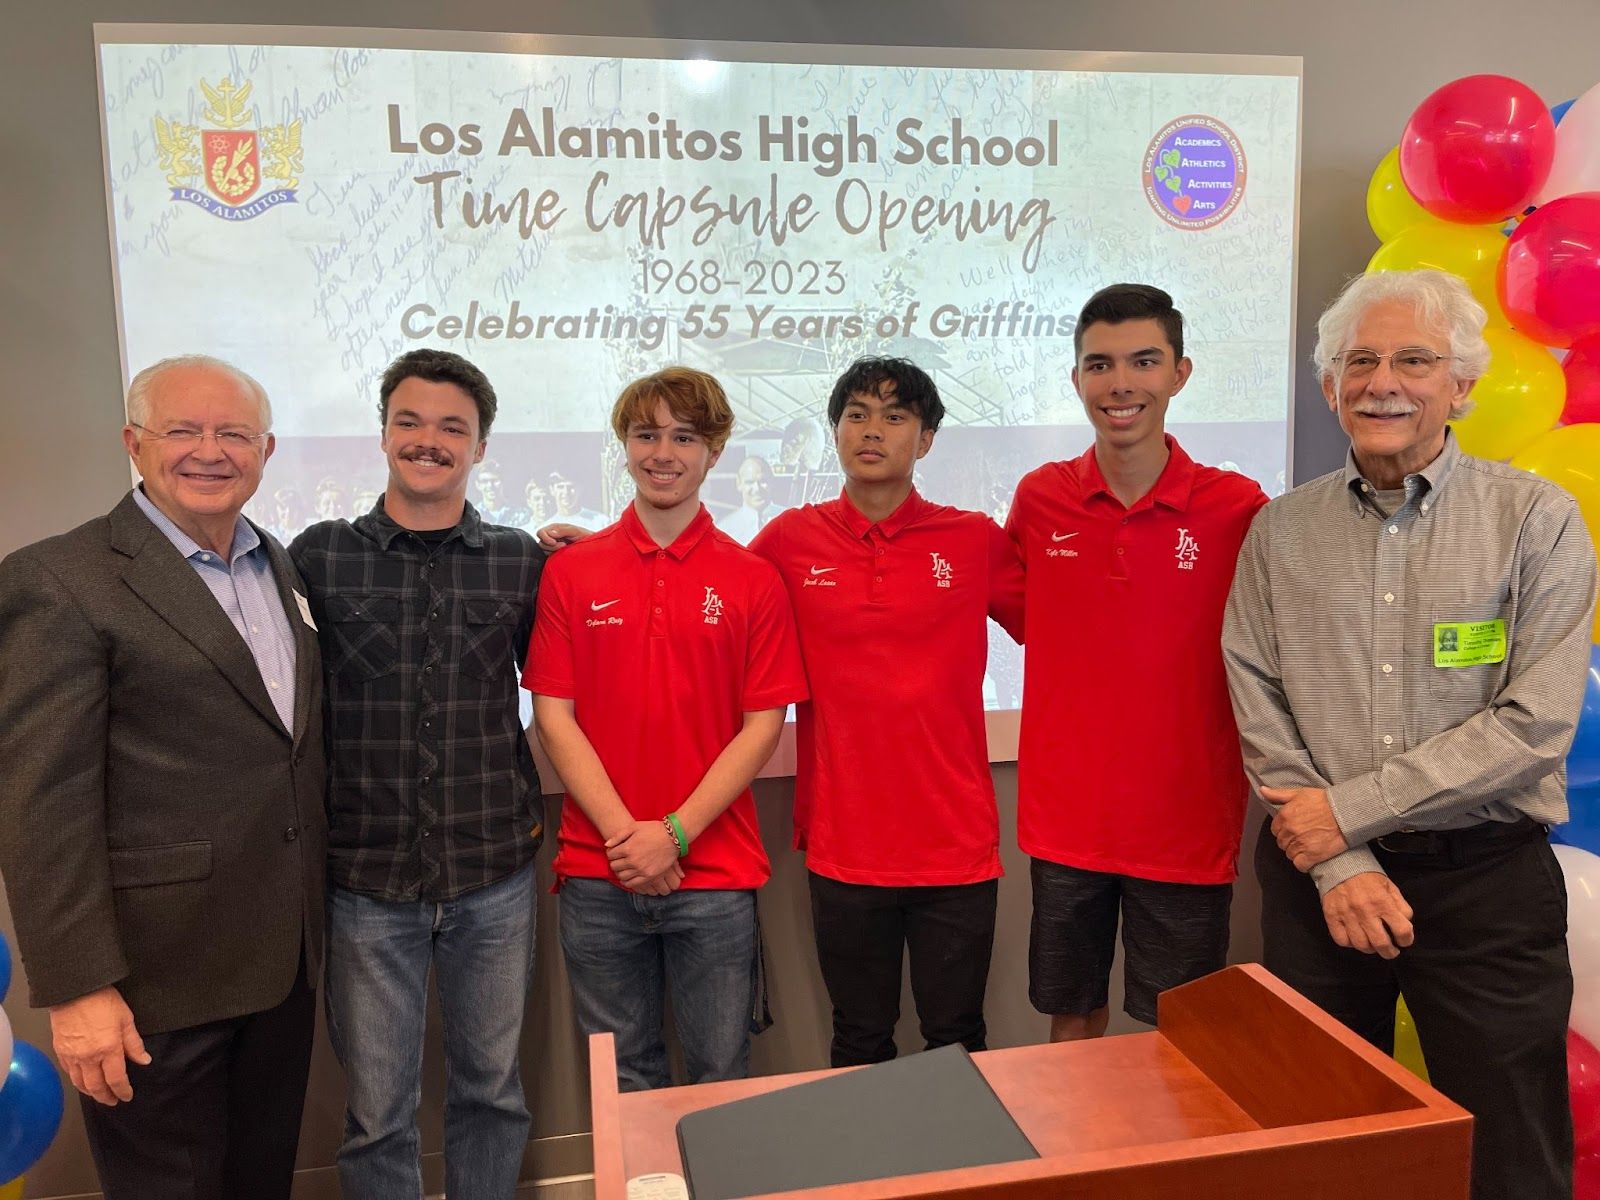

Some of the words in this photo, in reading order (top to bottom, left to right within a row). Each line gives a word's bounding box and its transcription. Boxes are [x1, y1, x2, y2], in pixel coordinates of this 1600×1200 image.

[387, 103, 483, 155] Los
[498, 107, 743, 161] Alamitos
[758, 115, 877, 177] High
[893, 117, 1058, 167] School
[1145, 156, 1154, 173] LOS
[1150, 124, 1177, 156] ALAMITOS
[1176, 119, 1205, 128] UNIFIED
[1206, 120, 1231, 141] SCHOOL
[1230, 139, 1244, 173] DISTRICT
[1174, 137, 1222, 147] ACADEMICS
[1181, 158, 1226, 168] ATHLETICS
[1188, 179, 1233, 189] ACTIVITIES
[180, 189, 211, 212] LOS
[212, 191, 288, 219] ALAMITOS
[1193, 200, 1216, 209] ARTS
[413, 170, 568, 240] Time
[585, 171, 820, 251] Capsule
[835, 178, 1056, 274] Opening
[1167, 214, 1205, 228] UNLIMITED
[640, 258, 847, 296] 1968-2023
[400, 301, 667, 351] Celebrating
[677, 304, 731, 340] 55
[745, 304, 864, 340] Years
[876, 301, 920, 338] of
[929, 301, 1077, 338] Griffins
[1177, 561, 1194, 570] ASB
[937, 580, 950, 588] ASB
[704, 617, 718, 625] ASB
